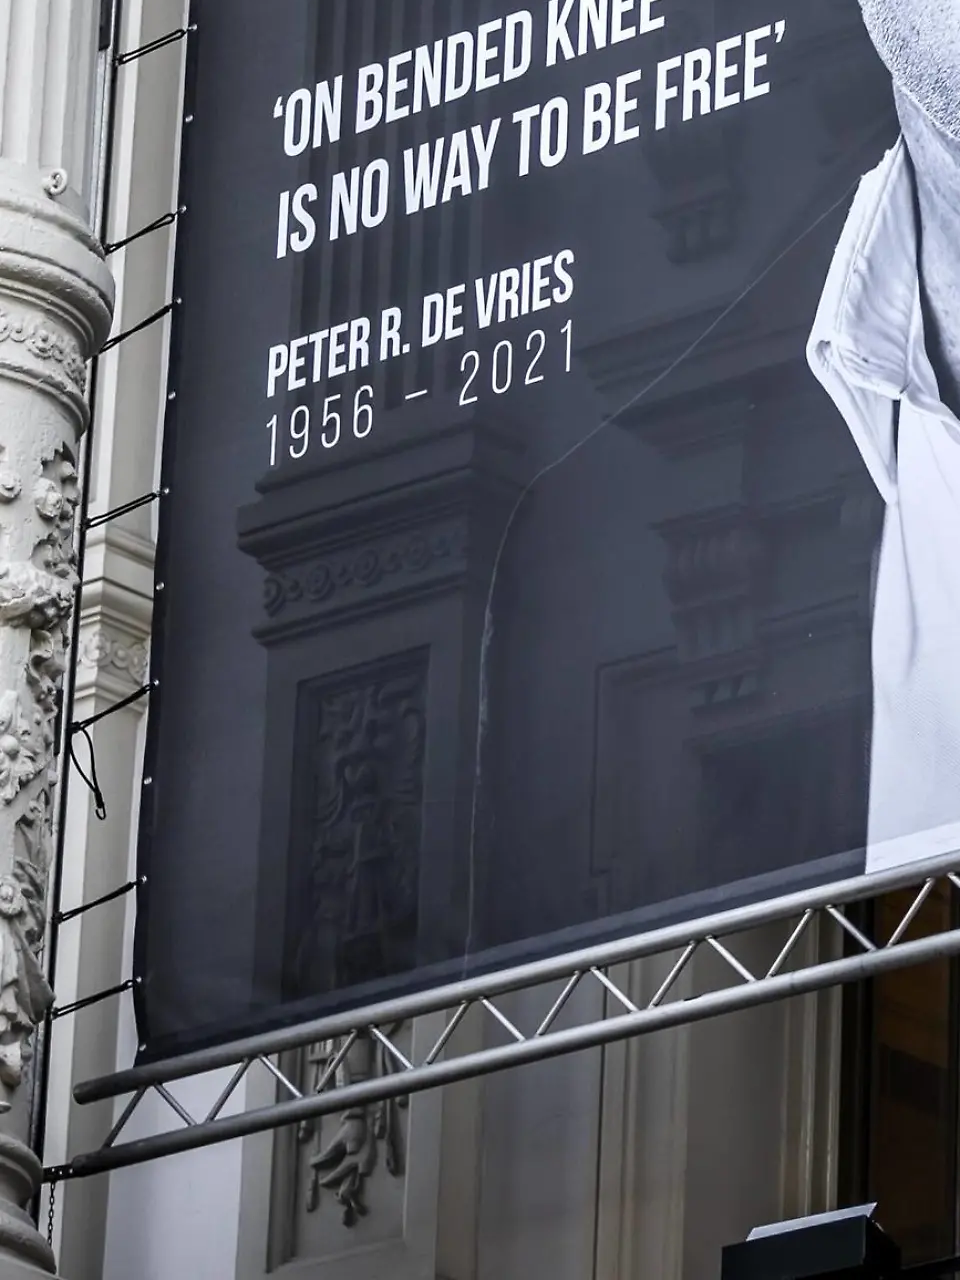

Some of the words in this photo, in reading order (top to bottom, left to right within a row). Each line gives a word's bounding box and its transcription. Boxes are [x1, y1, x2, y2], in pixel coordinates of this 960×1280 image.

[355, 10, 533, 134] BENDED
[276, 183, 318, 259] IS
[329, 158, 390, 241] NO
[403, 117, 502, 215] WAY
[511, 96, 569, 177] TO
[582, 68, 642, 156] BE
[266, 316, 371, 398] PETER
[379, 306, 411, 362] R.
[421, 283, 466, 348] DE
[474, 249, 575, 329] VRIES
[266, 384, 374, 466] 1956
[458, 319, 572, 406] 2021
